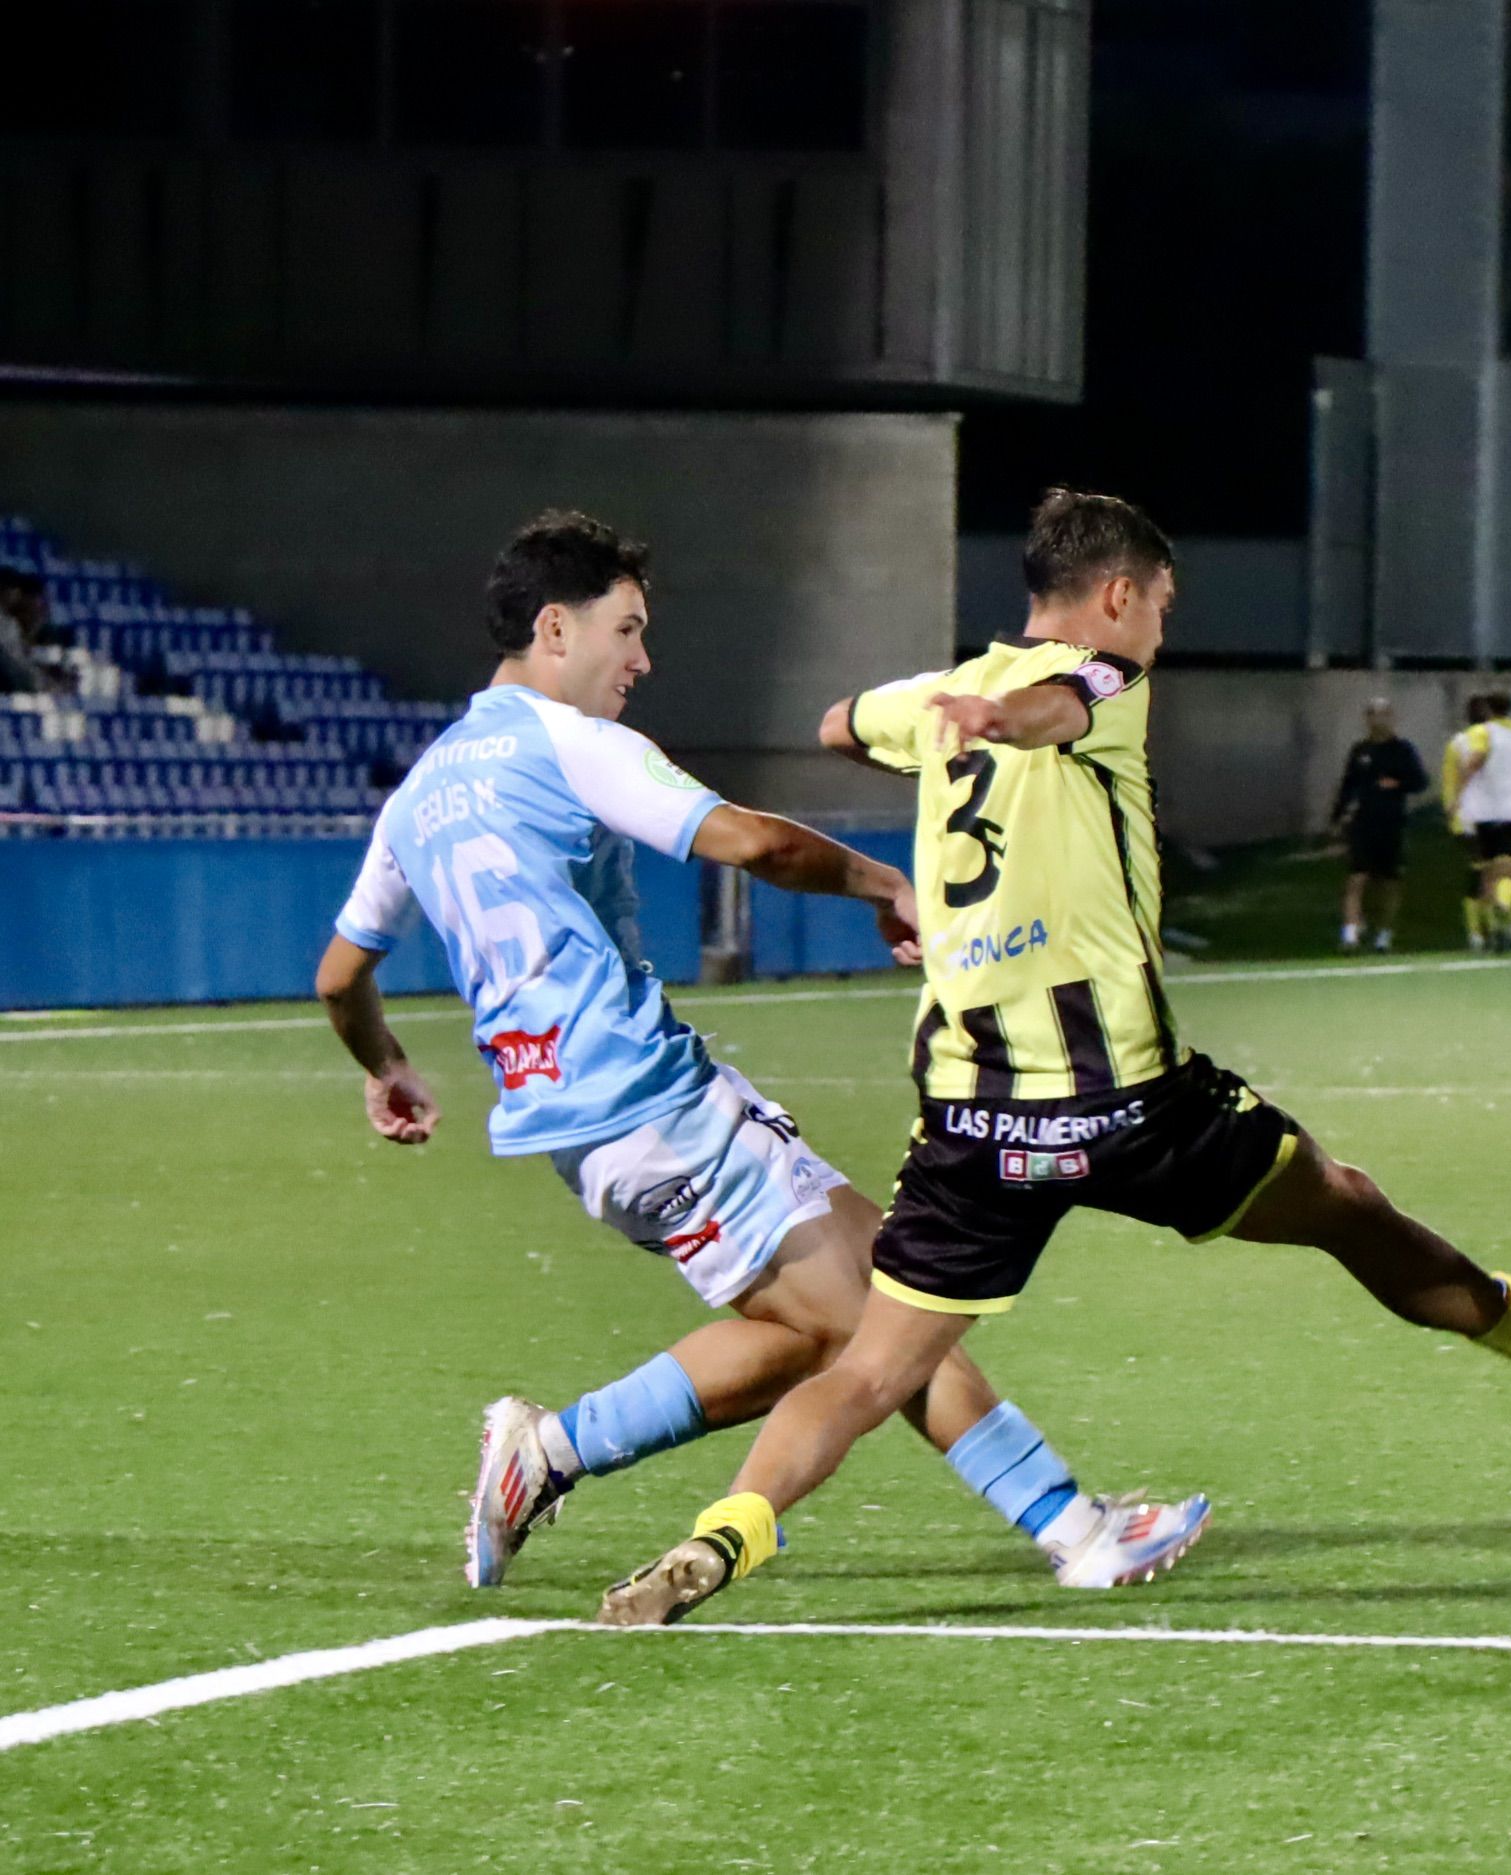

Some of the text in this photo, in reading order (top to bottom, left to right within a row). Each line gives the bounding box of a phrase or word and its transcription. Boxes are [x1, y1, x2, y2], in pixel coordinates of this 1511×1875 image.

[943, 748, 1006, 909] 3
[432, 833, 548, 1005] 16
[946, 1104, 991, 1139] LAS
